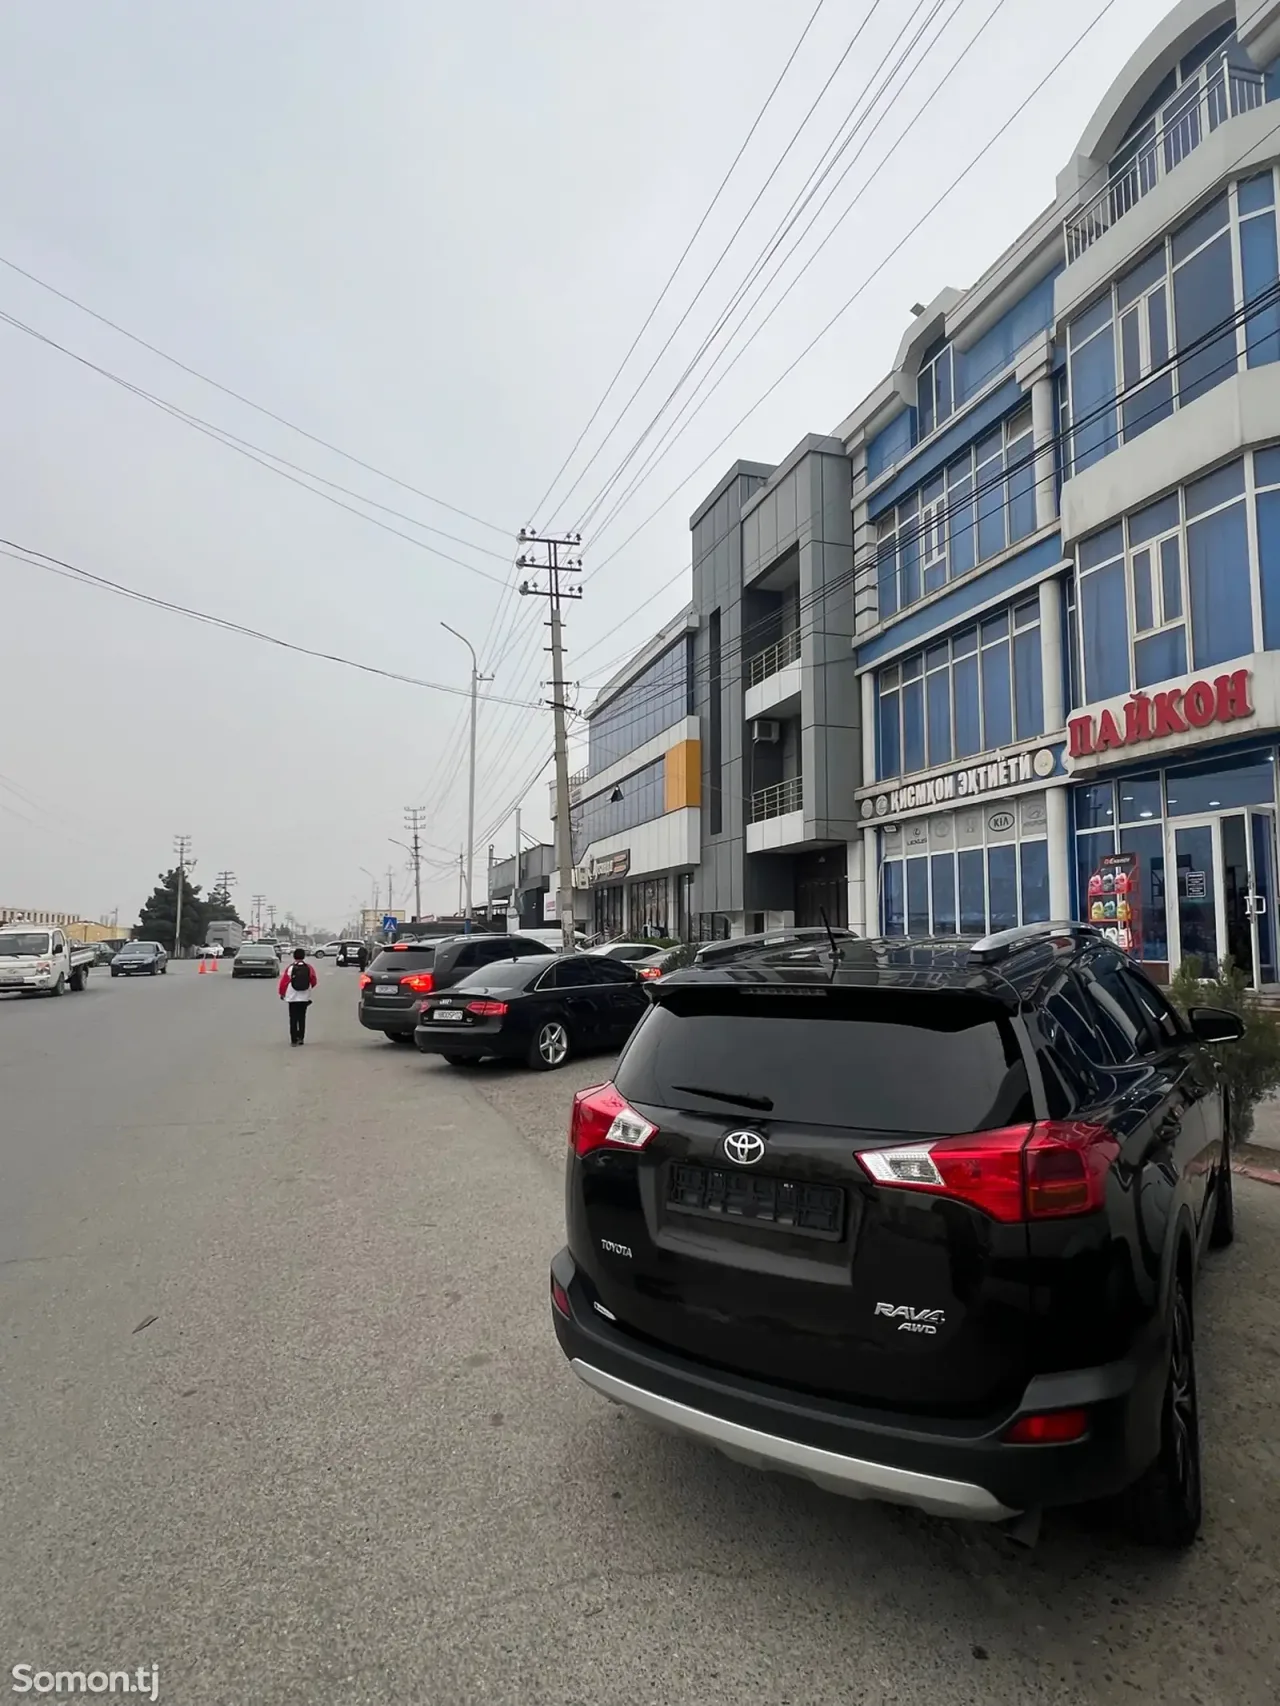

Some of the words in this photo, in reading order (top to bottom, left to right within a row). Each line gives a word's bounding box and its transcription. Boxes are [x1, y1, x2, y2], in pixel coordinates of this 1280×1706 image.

[1068, 668, 1255, 759] ПАЙКОН
[993, 816, 1010, 827] KIA
[601, 1238, 633, 1259] TOYOTA
[874, 1302, 946, 1325] RAV4
[897, 1322, 937, 1335] AWD
